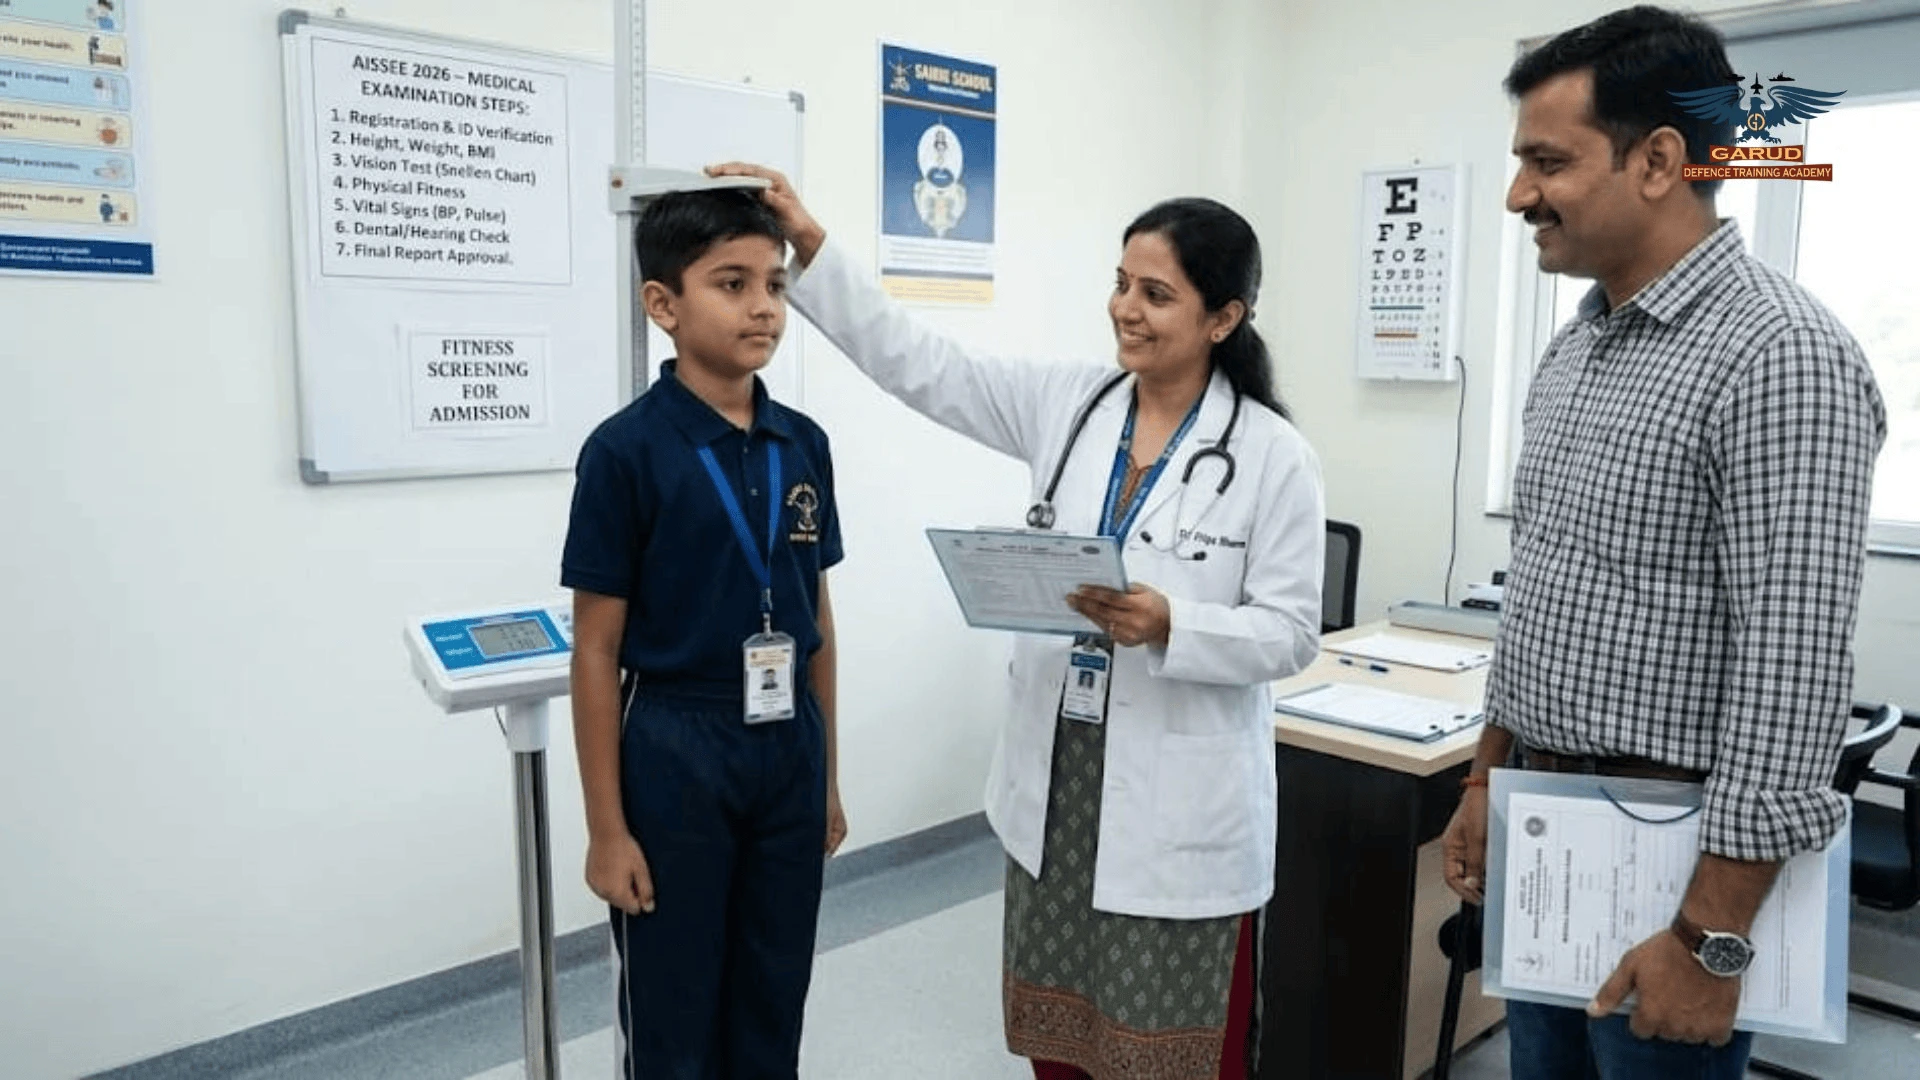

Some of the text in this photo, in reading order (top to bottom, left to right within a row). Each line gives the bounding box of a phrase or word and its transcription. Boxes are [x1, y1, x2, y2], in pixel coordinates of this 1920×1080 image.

[353, 55, 408, 76] AISSEE
[413, 64, 450, 81] 2026
[468, 72, 536, 94] MEDICAL
[361, 81, 530, 115] EXAMINATION STEPS:
[331, 109, 553, 146] 1. Registration & ID Verification
[331, 131, 495, 159] 2. Height, Weight, BMI
[332, 154, 536, 186] 3. Vision Test (Snellen Chart)
[333, 176, 466, 199] 4. Physical Fitness
[1385, 177, 1418, 214] E
[334, 198, 506, 224] 5. Vital Signs (BP, Pulse)
[335, 221, 510, 243] 6. Dental/Hearing Check
[336, 242, 513, 266] 7. Final Report Approval.
[442, 339, 514, 355] FITNESS
[427, 362, 529, 377] SCREENING
[462, 383, 499, 400] FOR
[430, 405, 530, 421] ADMISSION
